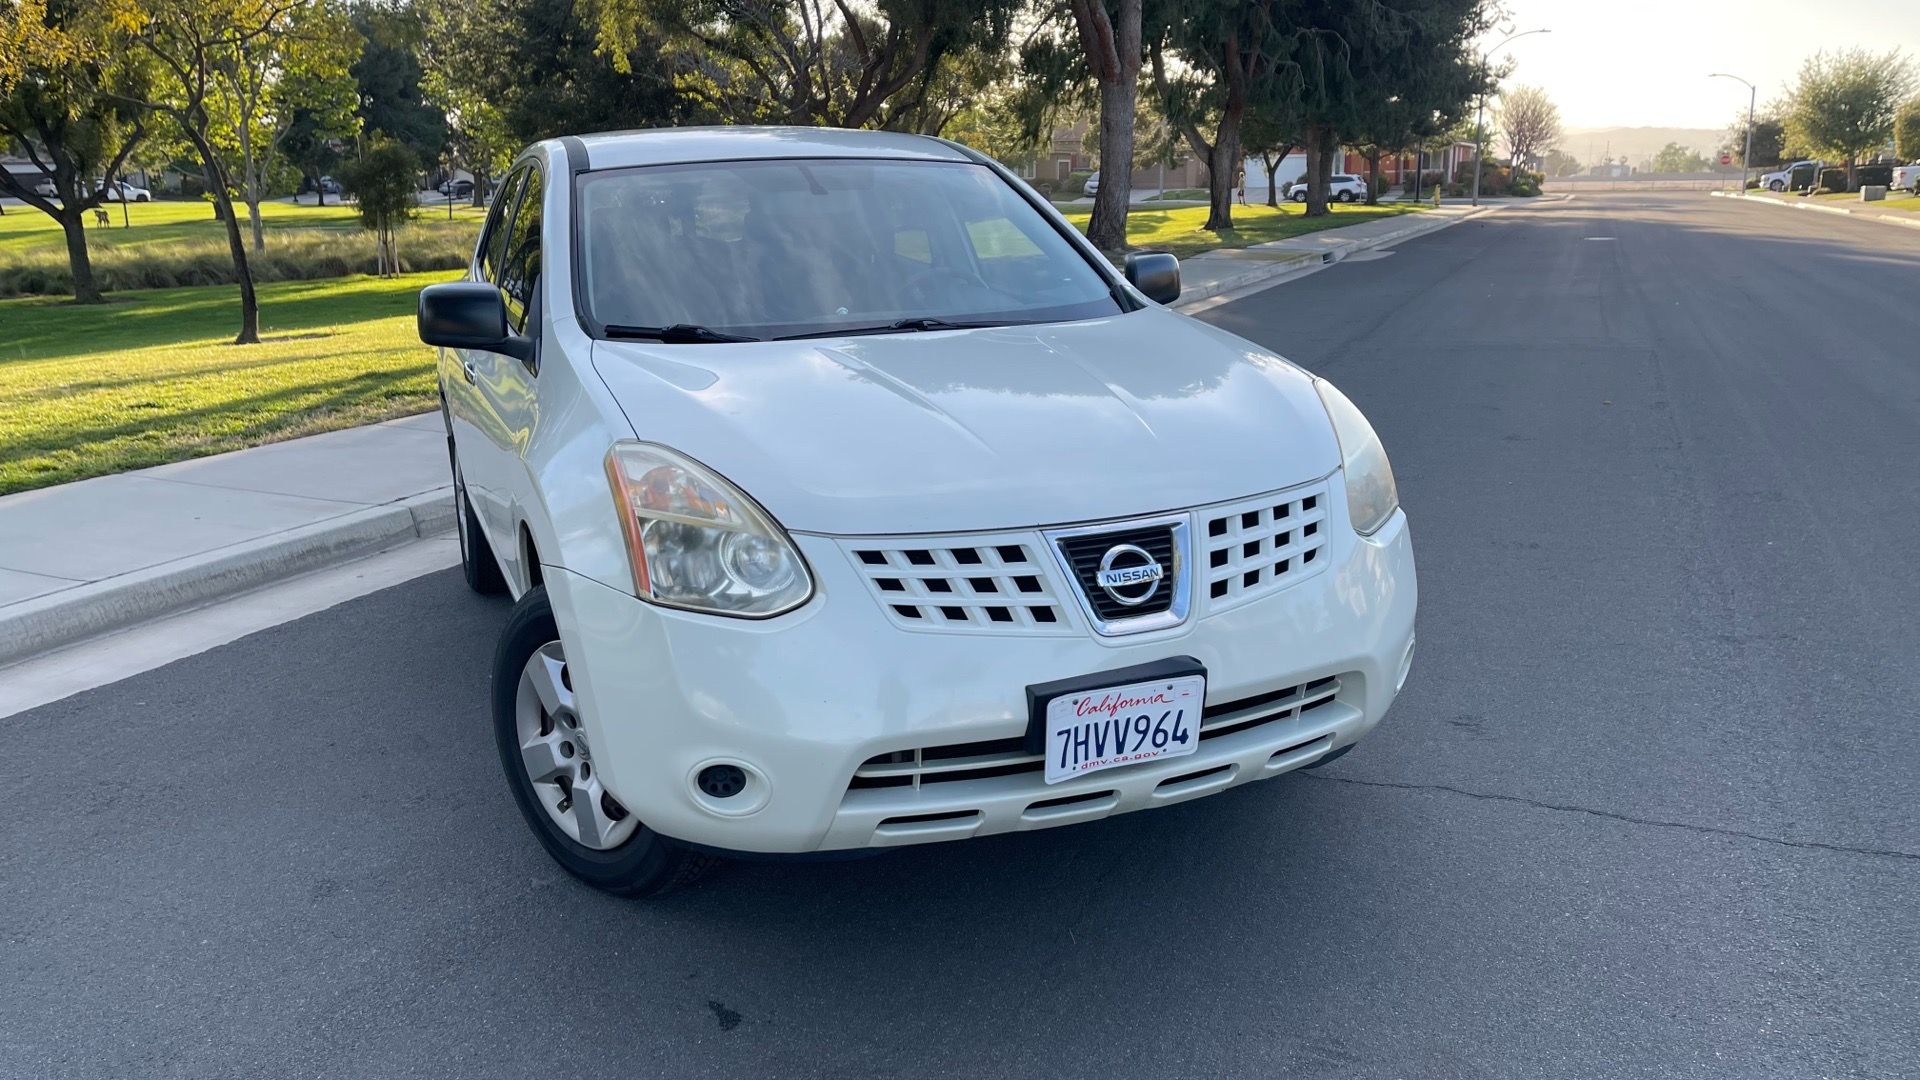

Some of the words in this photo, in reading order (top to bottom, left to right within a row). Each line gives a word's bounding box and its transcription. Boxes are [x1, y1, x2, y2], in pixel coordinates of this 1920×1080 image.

[1106, 567, 1159, 584] NISSAN
[1077, 692, 1174, 717] California
[1057, 709, 1189, 768] 7HVV964
[1081, 750, 1160, 770] dmv.ca.gov
